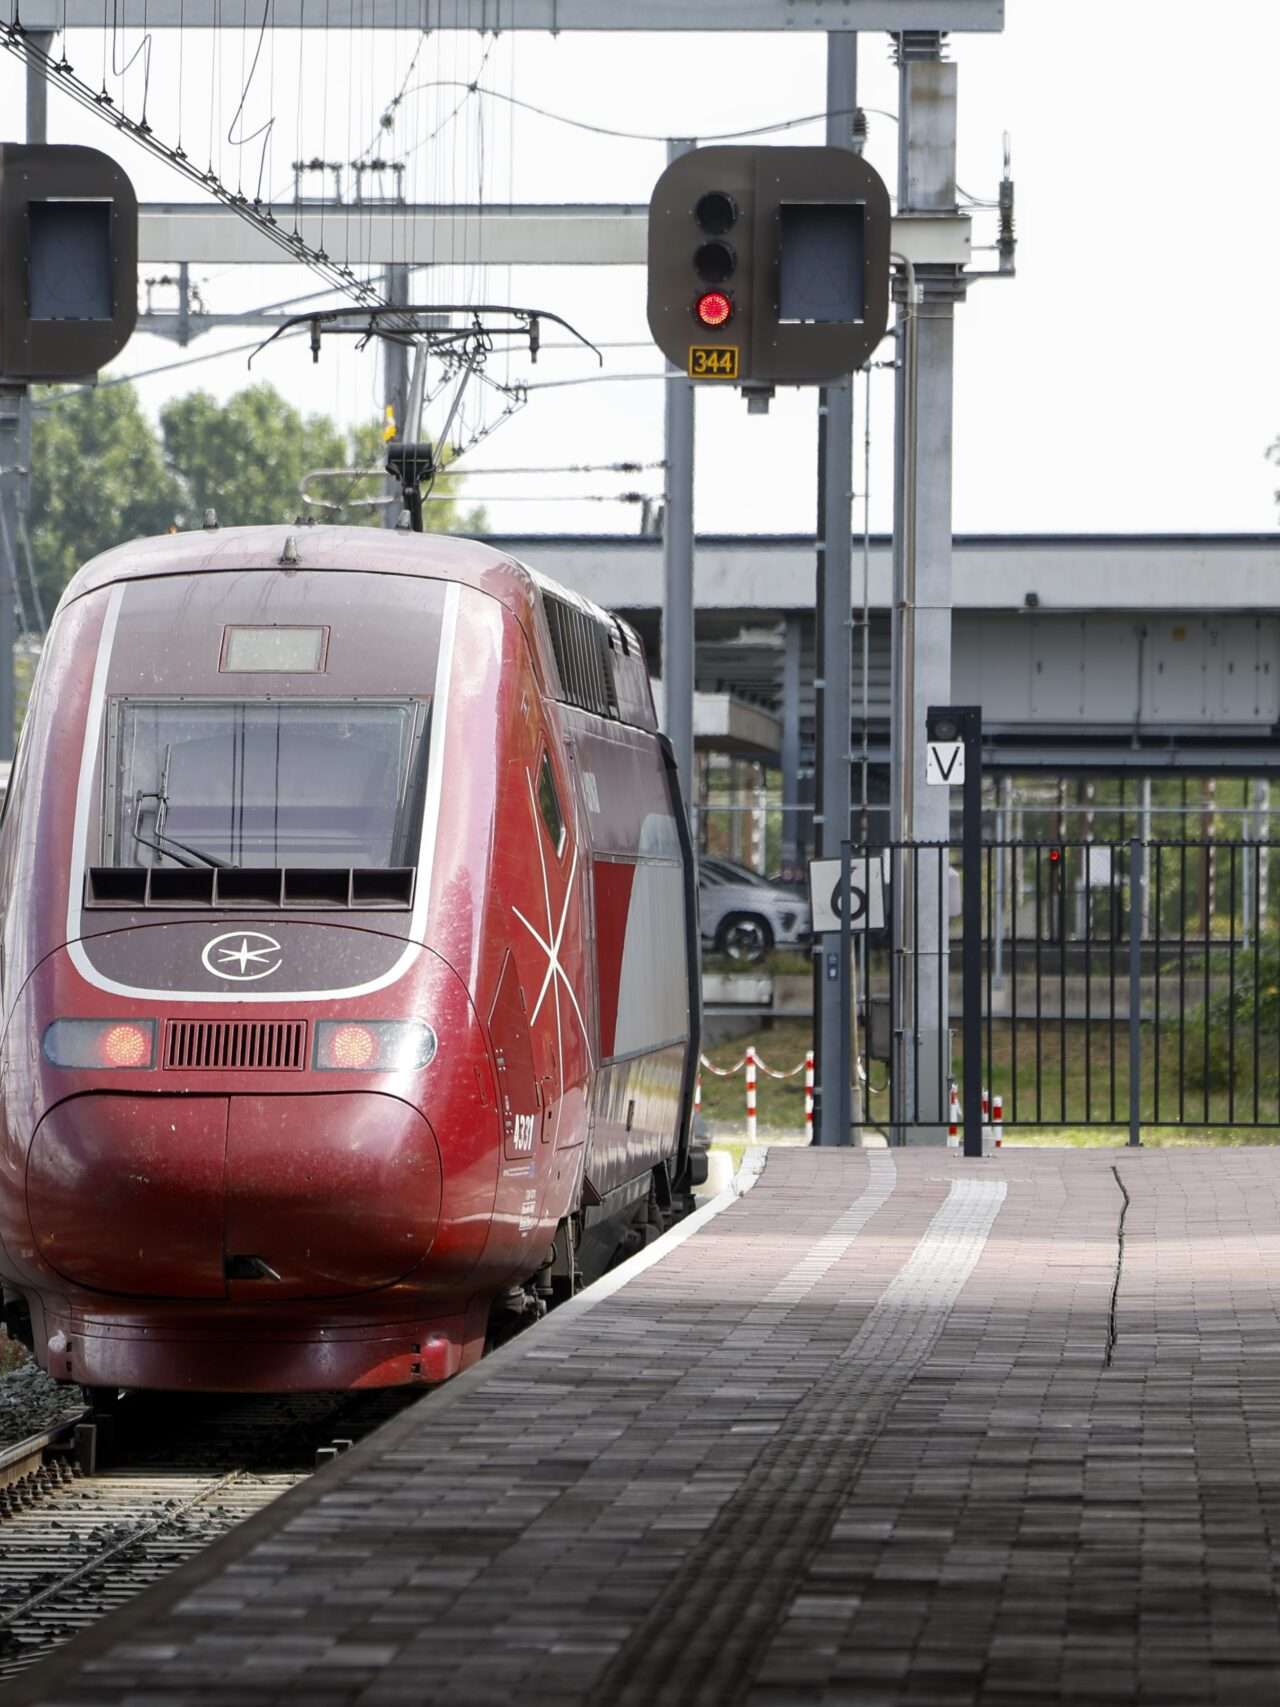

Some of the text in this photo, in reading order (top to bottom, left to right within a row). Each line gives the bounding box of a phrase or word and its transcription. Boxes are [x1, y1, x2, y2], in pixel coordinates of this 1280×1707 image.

[694, 350, 733, 373] 344
[931, 745, 961, 781] V
[830, 865, 866, 921] 6
[513, 1113, 535, 1150] 4331
